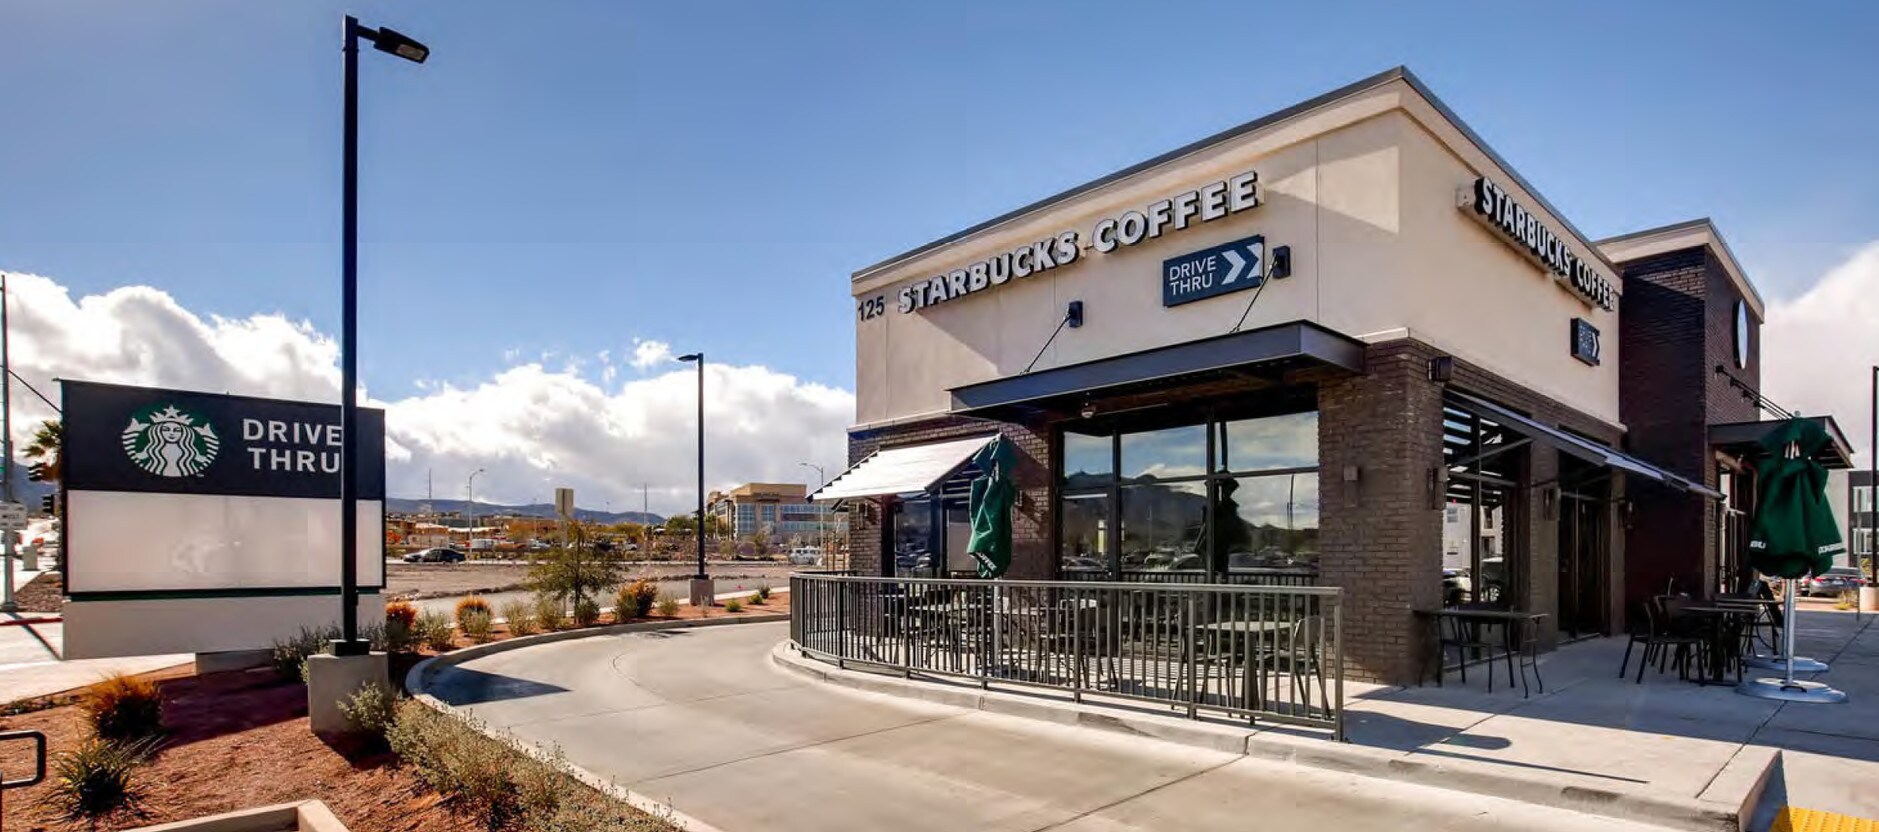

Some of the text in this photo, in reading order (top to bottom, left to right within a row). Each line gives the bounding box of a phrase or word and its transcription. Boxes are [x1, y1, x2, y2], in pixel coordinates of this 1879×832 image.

[898, 171, 1258, 314] STARBUCKS COFFEE
[1480, 177, 1615, 310] STARBUCKS COFFEE
[1169, 255, 1216, 281] DRIVE
[1169, 273, 1213, 295] THRU
[858, 296, 885, 321] 125
[243, 418, 342, 446] DRIVE
[247, 447, 340, 474] THRU
